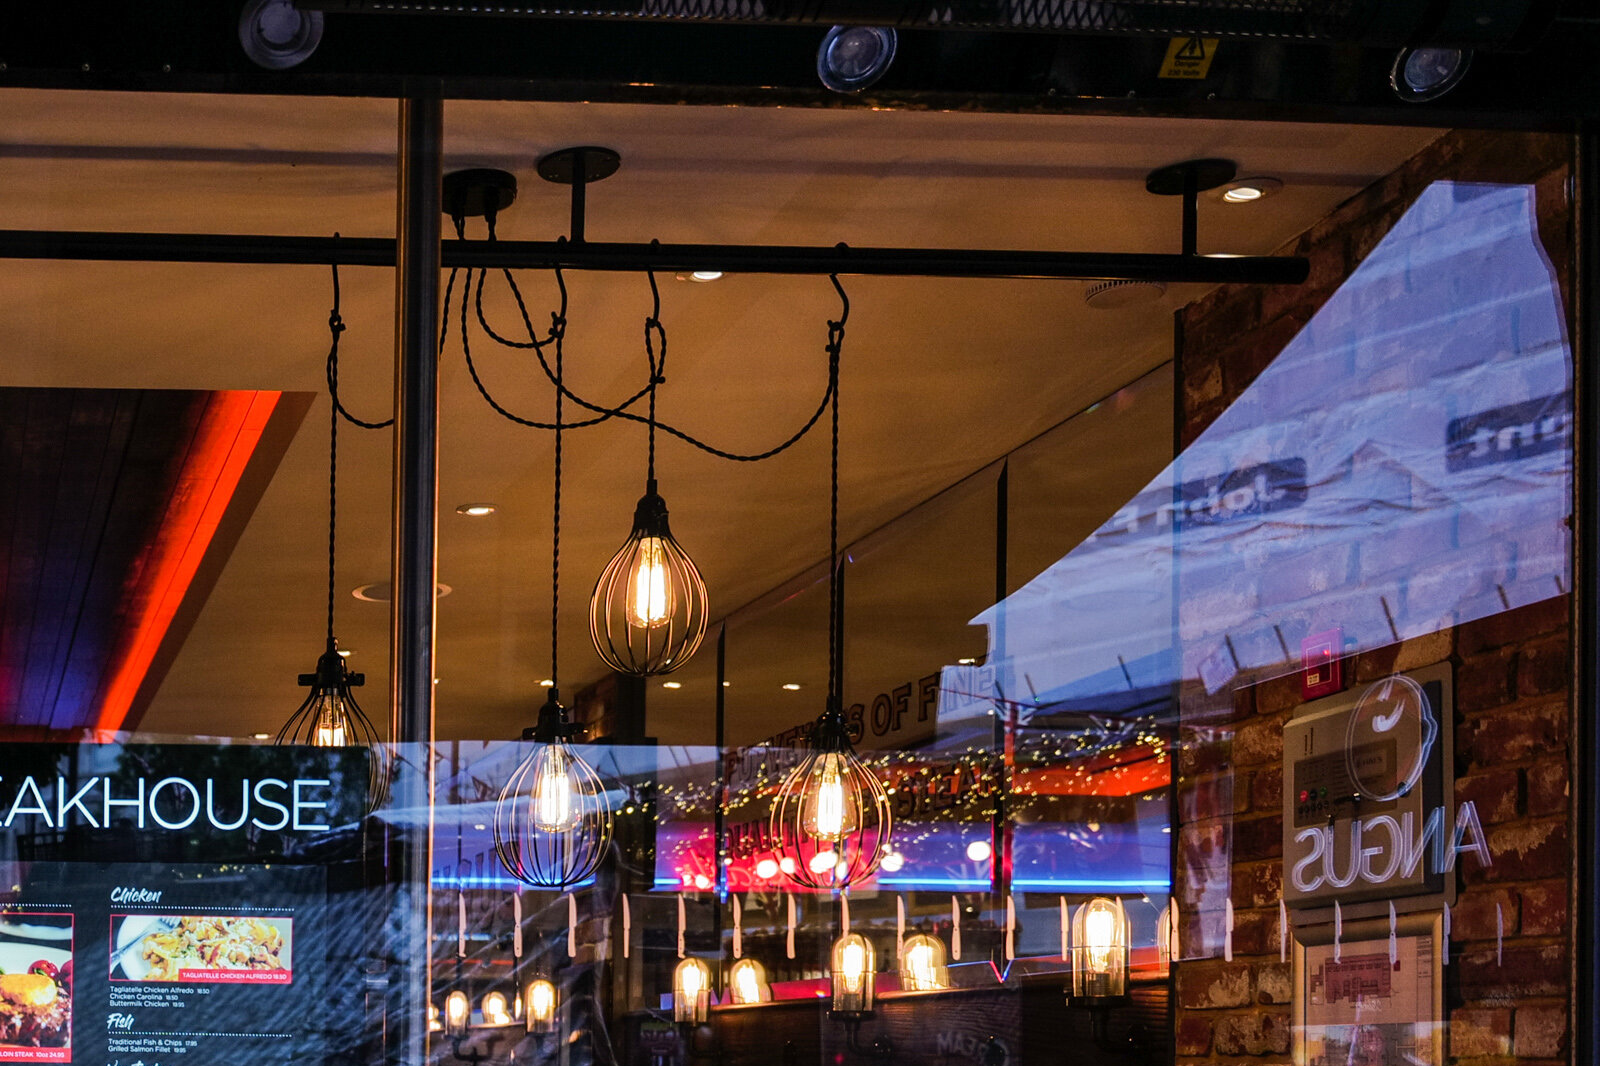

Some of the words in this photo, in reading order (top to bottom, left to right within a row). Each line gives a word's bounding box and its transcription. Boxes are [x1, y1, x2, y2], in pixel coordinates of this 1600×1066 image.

[871, 682, 911, 737] OF
[110, 887, 162, 904] Chicken
[107, 1013, 134, 1030] Fish
